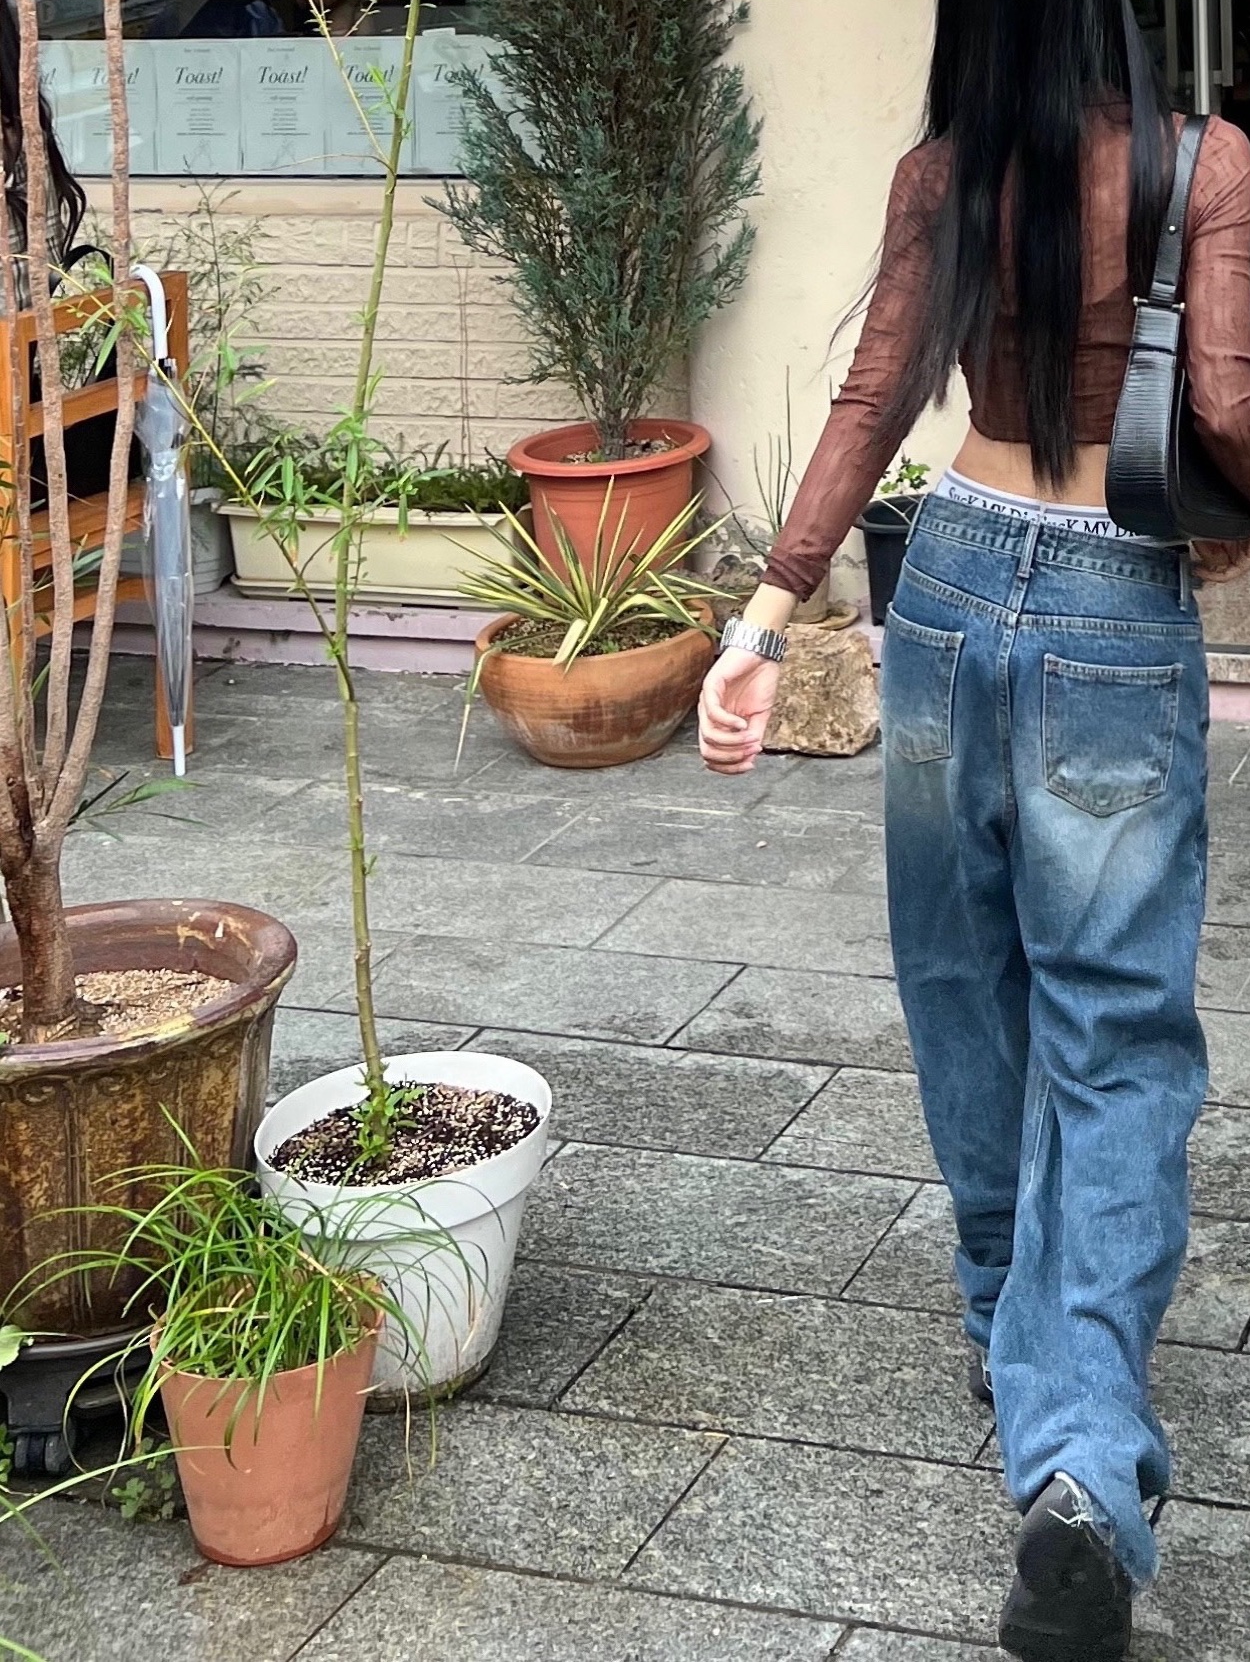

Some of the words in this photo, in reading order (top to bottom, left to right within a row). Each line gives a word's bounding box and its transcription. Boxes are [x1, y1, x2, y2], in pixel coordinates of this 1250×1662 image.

[175, 67, 224, 85] Toast!
[258, 65, 309, 84] Toast!
[346, 64, 395, 83] Toat!
